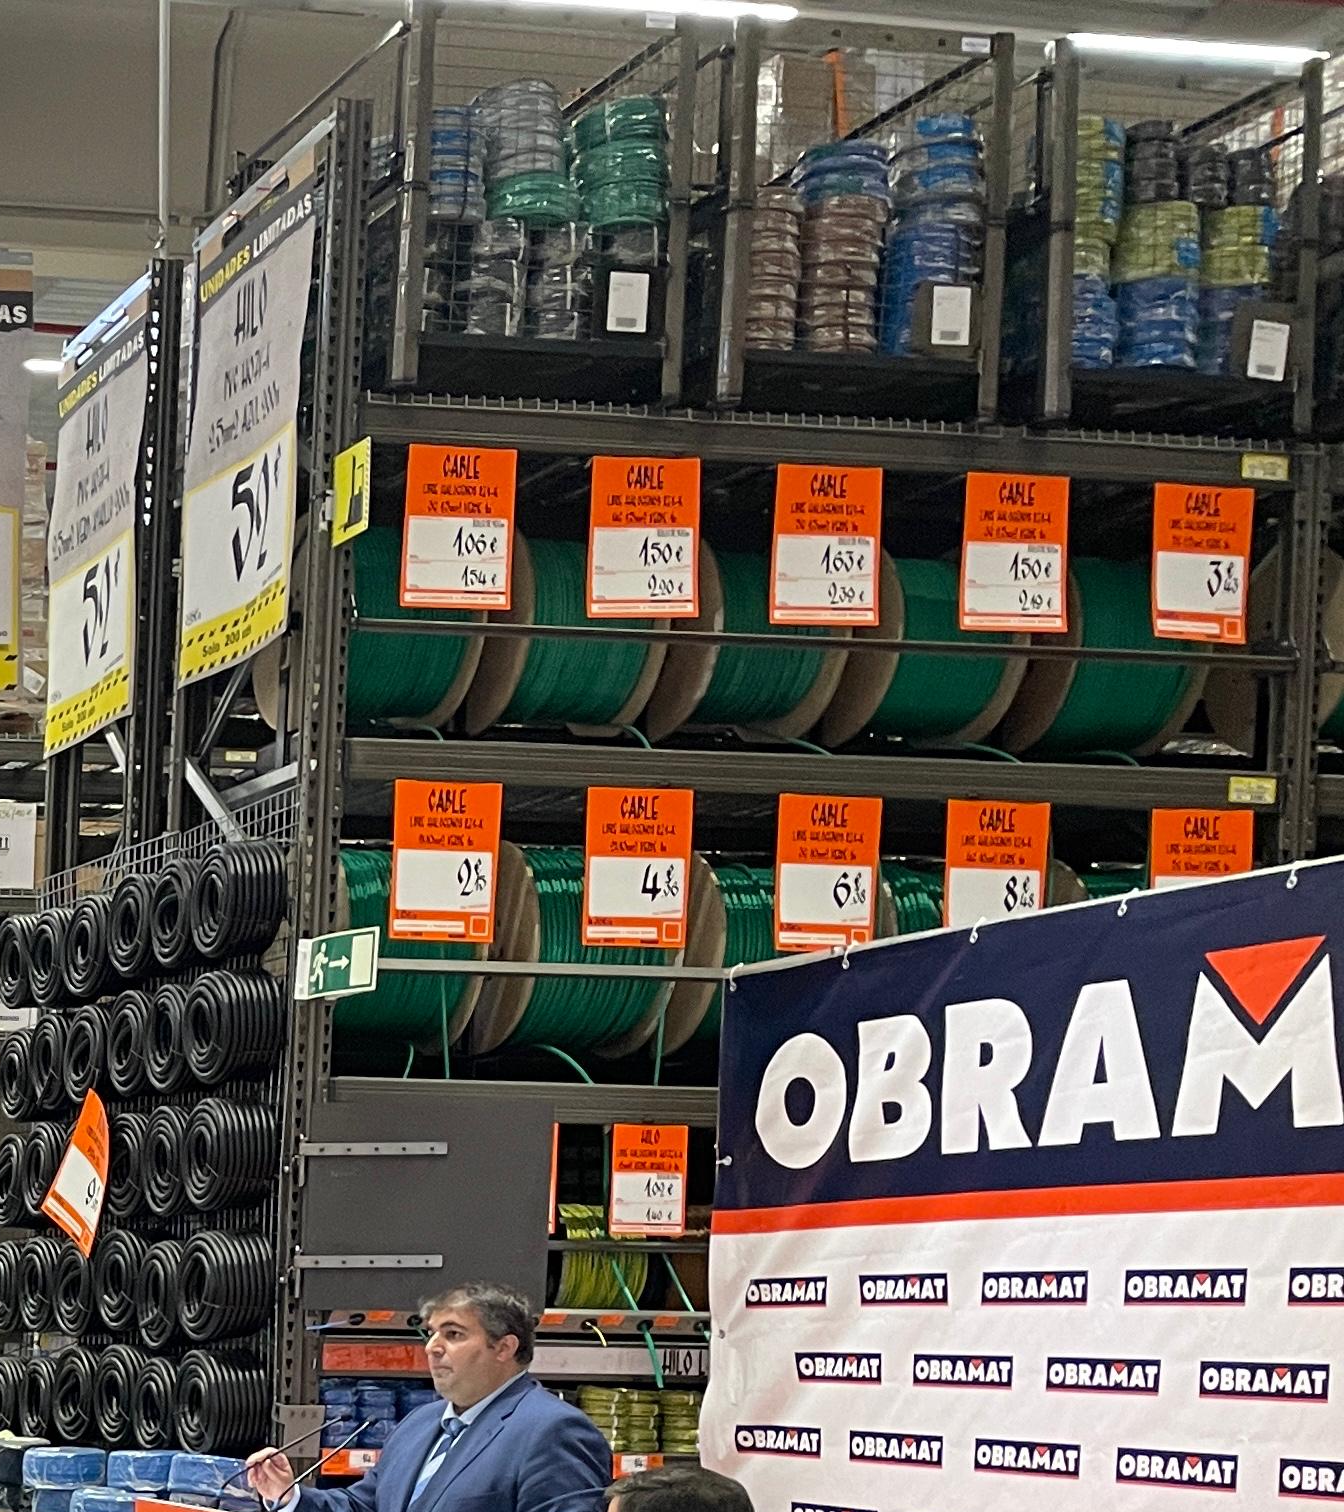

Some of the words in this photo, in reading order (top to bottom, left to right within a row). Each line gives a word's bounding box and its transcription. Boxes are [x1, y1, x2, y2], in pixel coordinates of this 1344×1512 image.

[200, 245, 251, 302] UNIDADES
[253, 193, 312, 257] LIMITADAS
[58, 370, 98, 418] UNIDADES
[99, 330, 145, 382] LIMITADAS
[443, 454, 480, 479] CABLE
[627, 465, 664, 490] CABLE
[811, 473, 848, 499] CABLE
[999, 482, 1036, 506] CABLE
[1185, 492, 1221, 518] CABLE
[428, 789, 467, 814] CABLE
[621, 795, 660, 821] CABLE
[811, 803, 849, 829] CABLE
[979, 808, 1017, 833] CABLE
[1183, 815, 1220, 841] CABLE
[755, 953, 1344, 1170] OBRAM
[747, 1281, 825, 1304] OBRAMAT
[862, 1276, 946, 1302] OBRAMAT
[984, 1274, 1086, 1300] OBRAMAT
[1127, 1273, 1245, 1300] OBRAMAT
[662, 1350, 693, 1374] HILO
[799, 1356, 879, 1379] OBRAMAT
[915, 1358, 1011, 1383] OBRAMAT
[1049, 1362, 1159, 1389] OBRAMAT
[1202, 1367, 1328, 1395] OBRAMAT
[737, 1429, 818, 1453] OBRAMAT
[851, 1437, 941, 1463] OBRAMAT
[976, 1446, 1078, 1474] OBRAMAT
[1119, 1455, 1235, 1486] OBRAMAT
